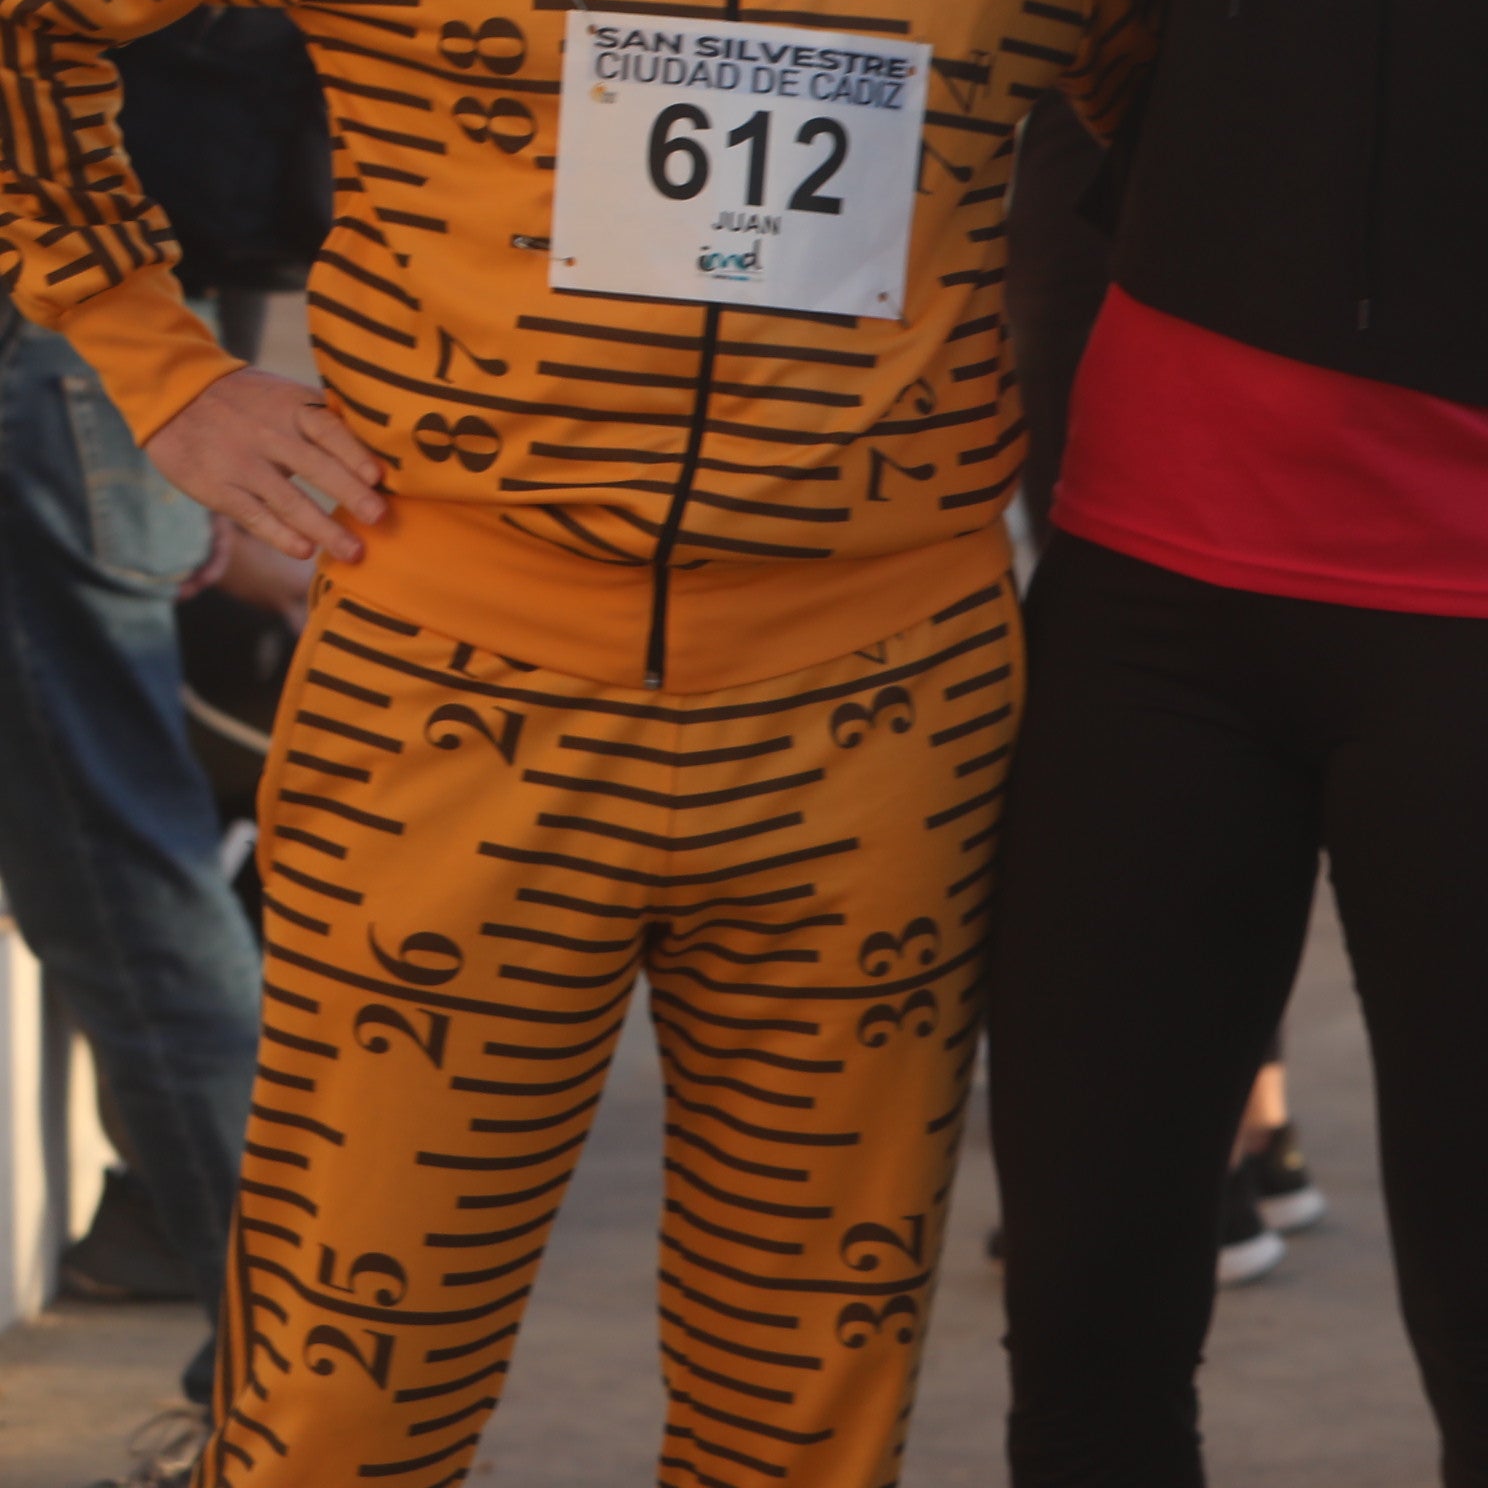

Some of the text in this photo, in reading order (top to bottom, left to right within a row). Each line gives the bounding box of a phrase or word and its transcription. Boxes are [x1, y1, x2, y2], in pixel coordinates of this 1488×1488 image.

[594, 26, 907, 78] SAN SILVESTRE
[595, 52, 739, 91] CIUDAD
[750, 65, 797, 95] DE
[648, 103, 849, 215] 612
[711, 211, 781, 235] JUAN
[352, 920, 467, 1072] 26
[856, 915, 944, 1051] 33
[302, 1242, 409, 1392] 25
[834, 1212, 928, 1352] 32
